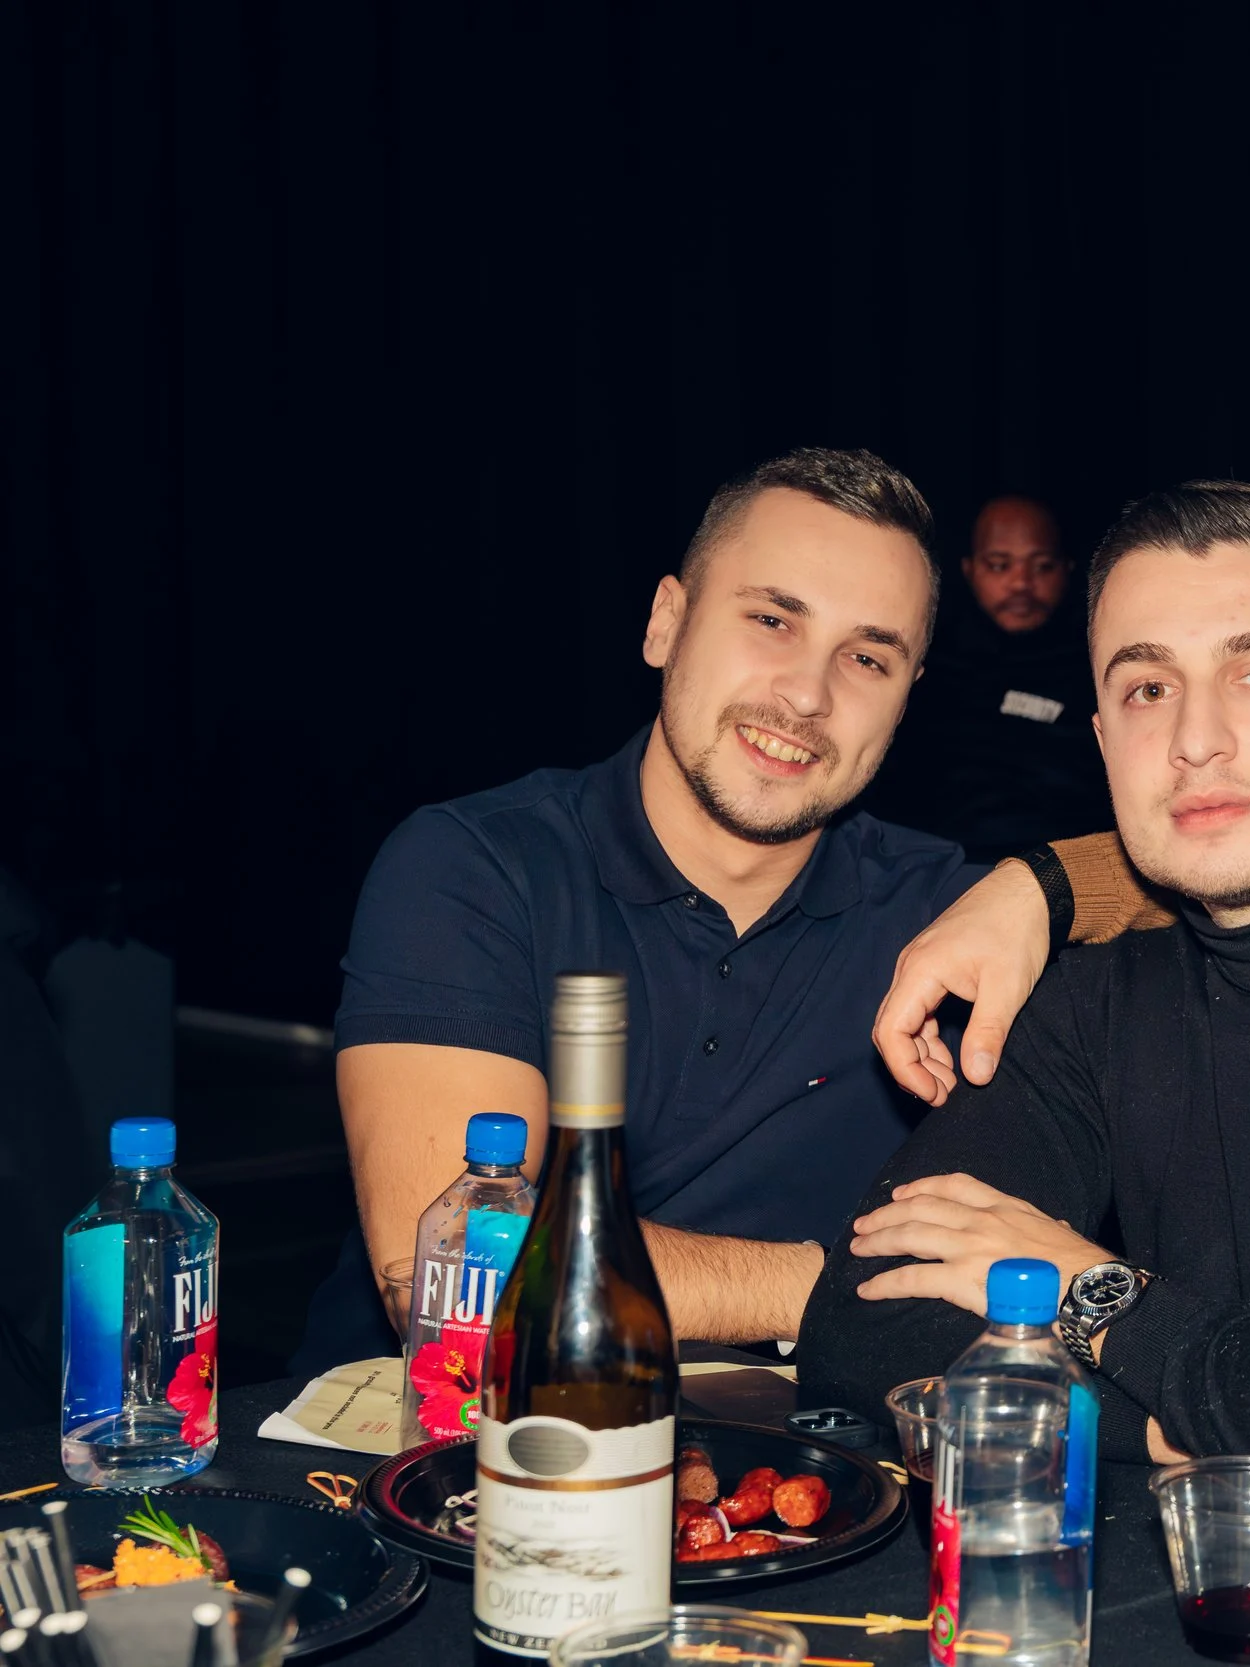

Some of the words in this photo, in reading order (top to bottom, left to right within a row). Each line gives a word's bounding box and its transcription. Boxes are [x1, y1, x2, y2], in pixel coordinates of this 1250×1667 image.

[420, 1259, 499, 1326] FIJI
[417, 1317, 443, 1329] NATURAL
[443, 1322, 473, 1334] ARTESIAN
[472, 1325, 491, 1335] WATE
